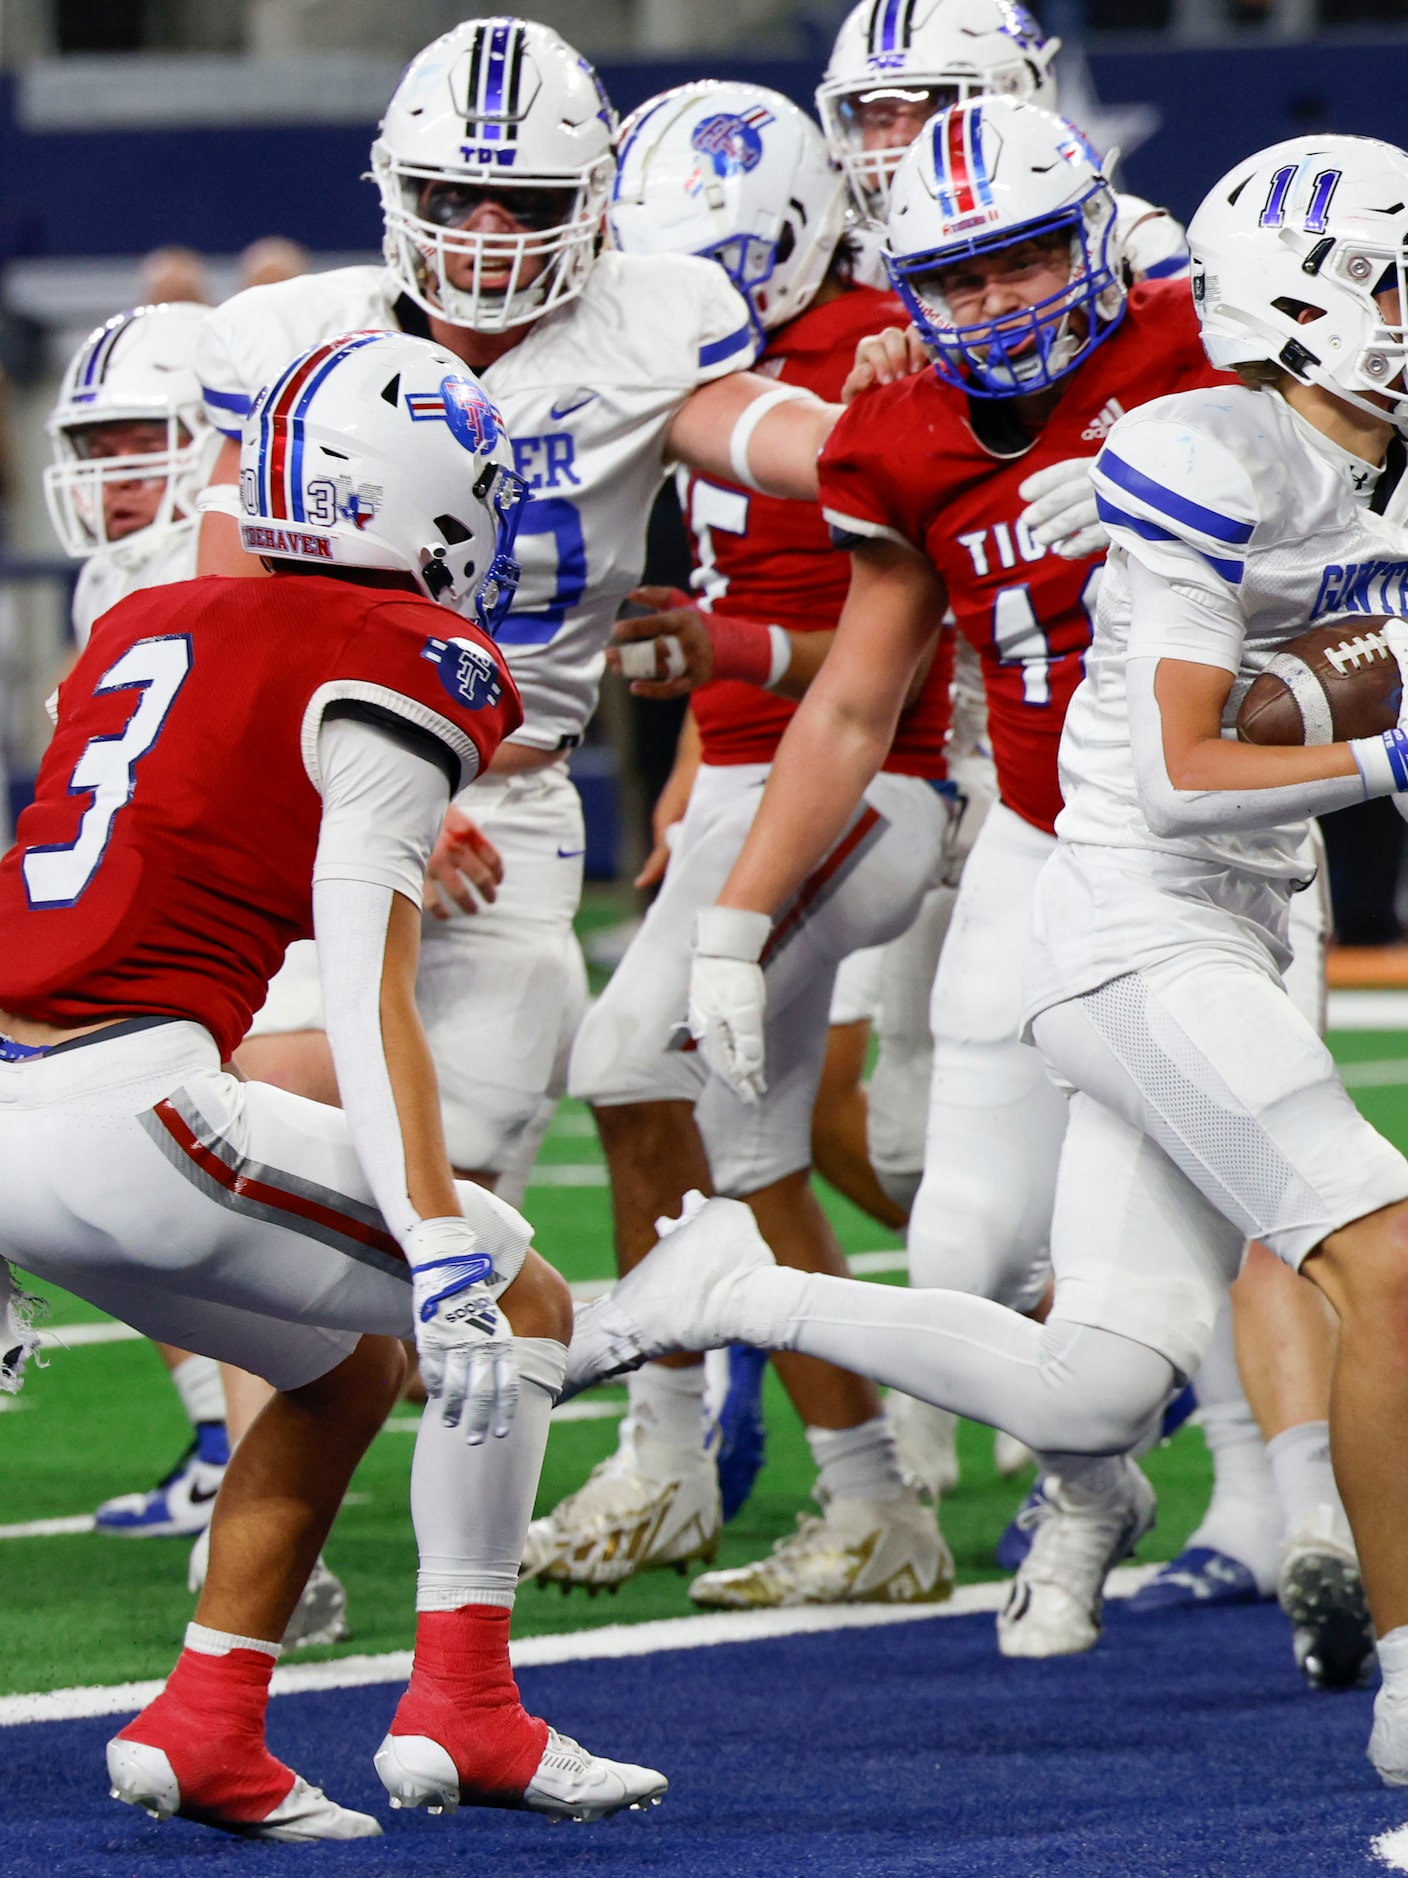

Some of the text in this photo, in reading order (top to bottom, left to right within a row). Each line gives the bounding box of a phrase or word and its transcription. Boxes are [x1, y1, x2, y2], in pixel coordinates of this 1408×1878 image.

[1259, 164, 1342, 234] 11
[307, 480, 337, 527] 3
[21, 633, 194, 912] 3
